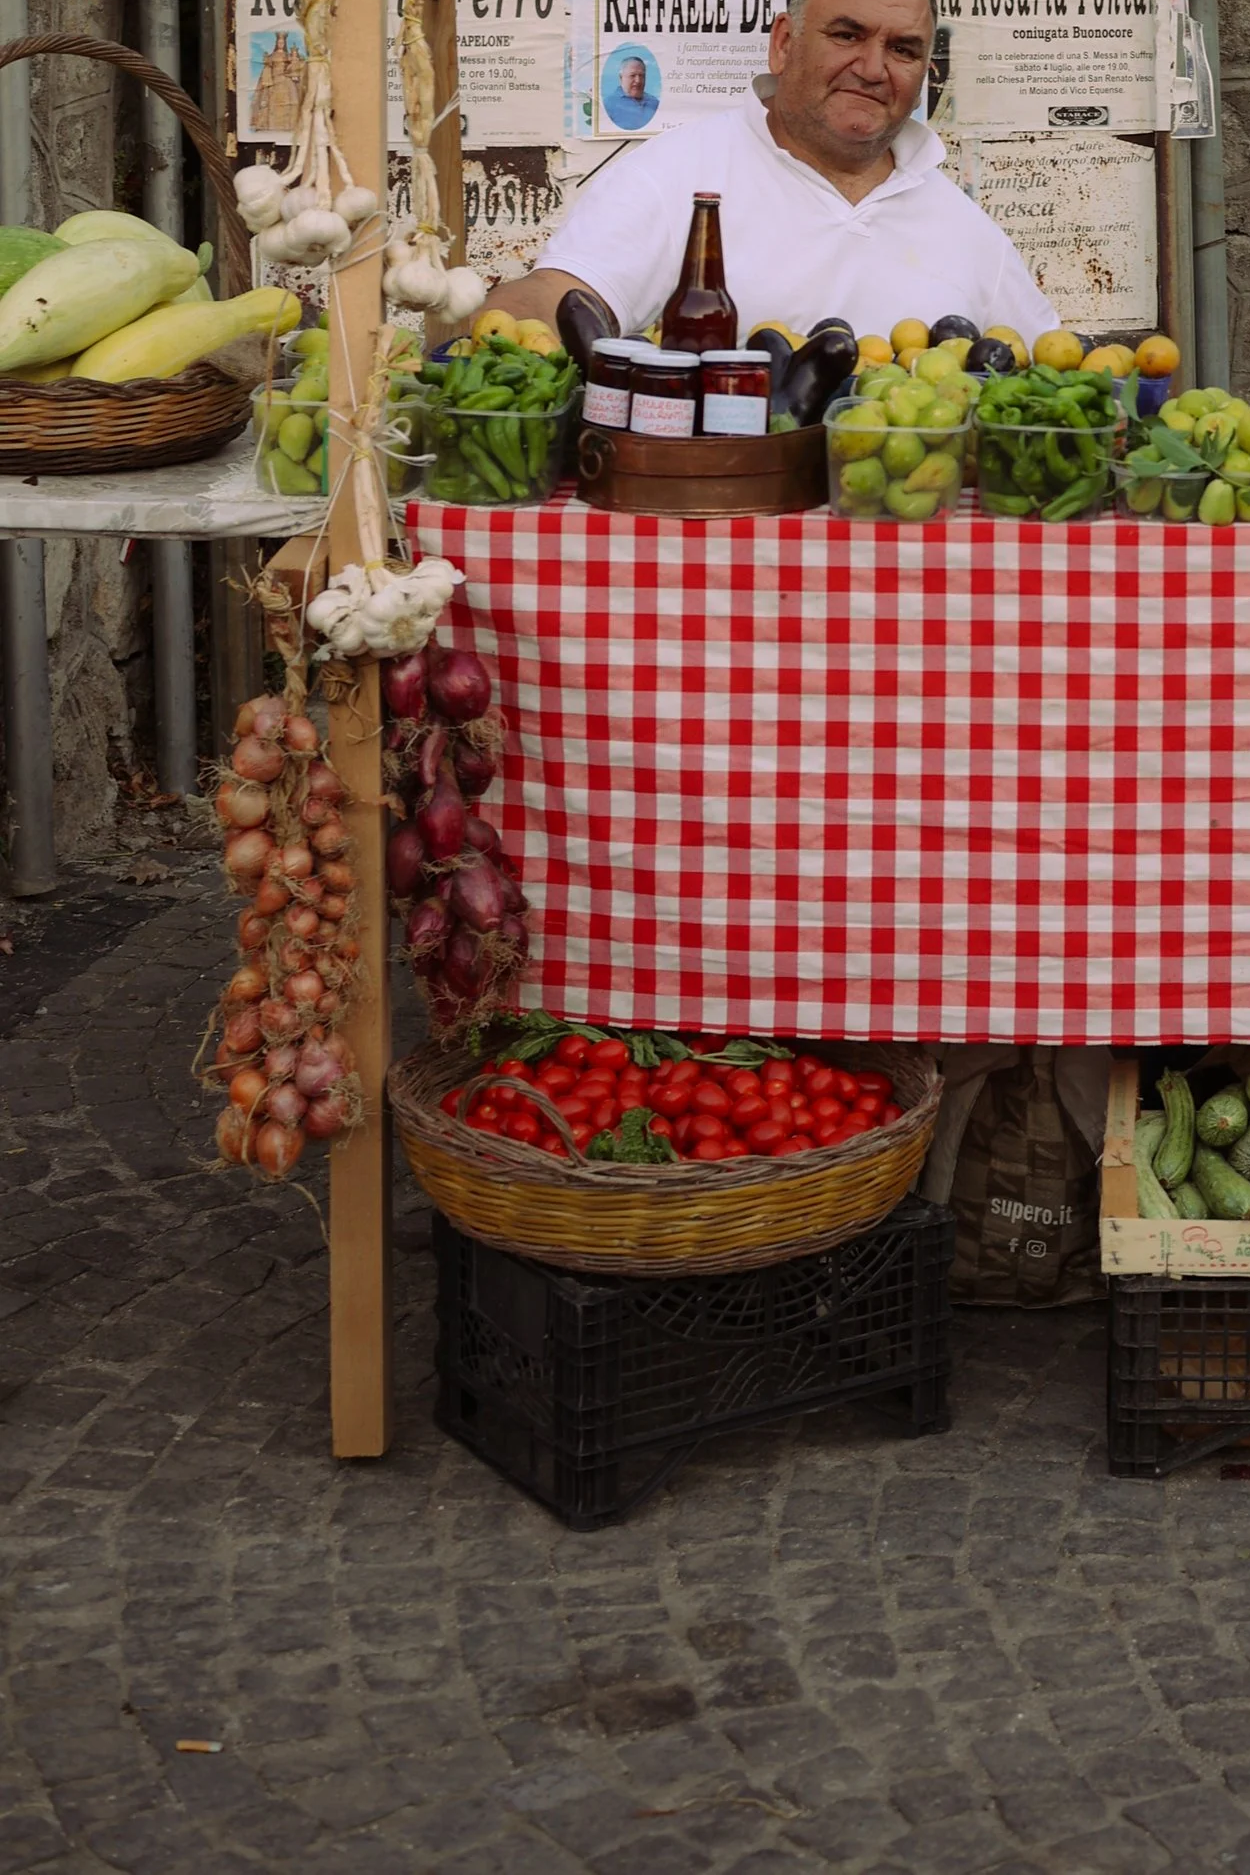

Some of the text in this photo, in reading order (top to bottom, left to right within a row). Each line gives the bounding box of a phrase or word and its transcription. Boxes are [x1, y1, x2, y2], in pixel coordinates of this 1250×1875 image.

[1013, 27, 1133, 41] coniugata Buonocore
[498, 56, 536, 66] Suffragio
[978, 53, 993, 61] con
[995, 52, 1002, 61] la
[1004, 52, 1054, 61] celebrazione
[1057, 52, 1064, 60] di
[1093, 52, 1118, 60] Messa
[1120, 52, 1128, 60] in
[1014, 63, 1041, 71] sabato
[1043, 63, 1048, 71] 4
[1077, 63, 1090, 71] alle
[976, 74, 1133, 84] nella Chiesa Parrocchiale di San Renato
[670, 85, 692, 93] nella
[696, 85, 727, 93] Chiesa
[991, 1198, 1072, 1225] supero.it
